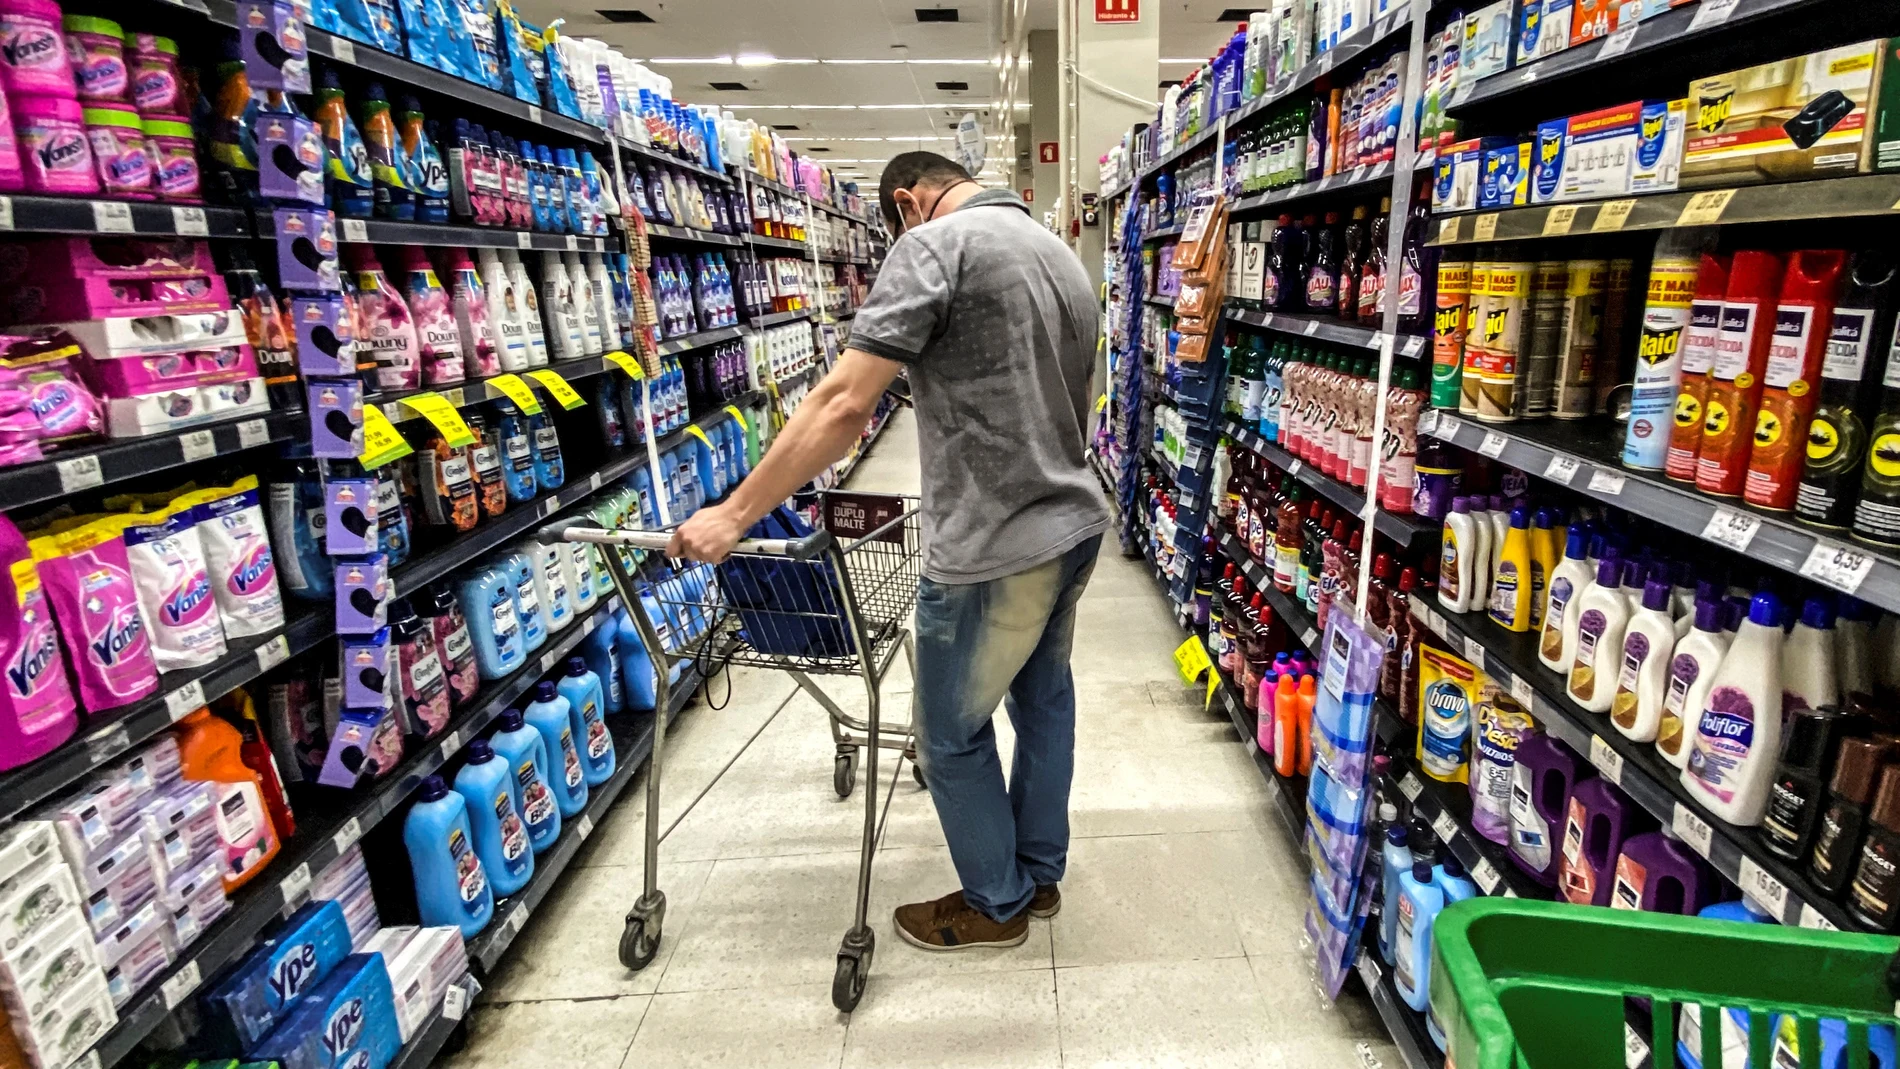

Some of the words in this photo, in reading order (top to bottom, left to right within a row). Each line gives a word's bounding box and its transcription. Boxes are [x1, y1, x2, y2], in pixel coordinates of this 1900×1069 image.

[1697, 95, 1733, 129] Raid
[1643, 117, 1664, 137] Raid
[1542, 138, 1560, 160] Raid
[1308, 275, 1330, 293] UAU
[1444, 272, 1469, 281] MAIS
[1493, 275, 1517, 284] MAIS
[428, 331, 459, 343] Down
[1639, 331, 1680, 357] Raid
[833, 506, 865, 520] DUPLO
[1728, 512, 1751, 532] 8,59
[833, 517, 865, 531] MALTE
[1832, 547, 1864, 571] 8,59
[414, 657, 439, 681] Comfort
[1430, 687, 1466, 713] bravo
[1701, 712, 1747, 737] Poliflor
[1712, 740, 1746, 754] Lavanda
